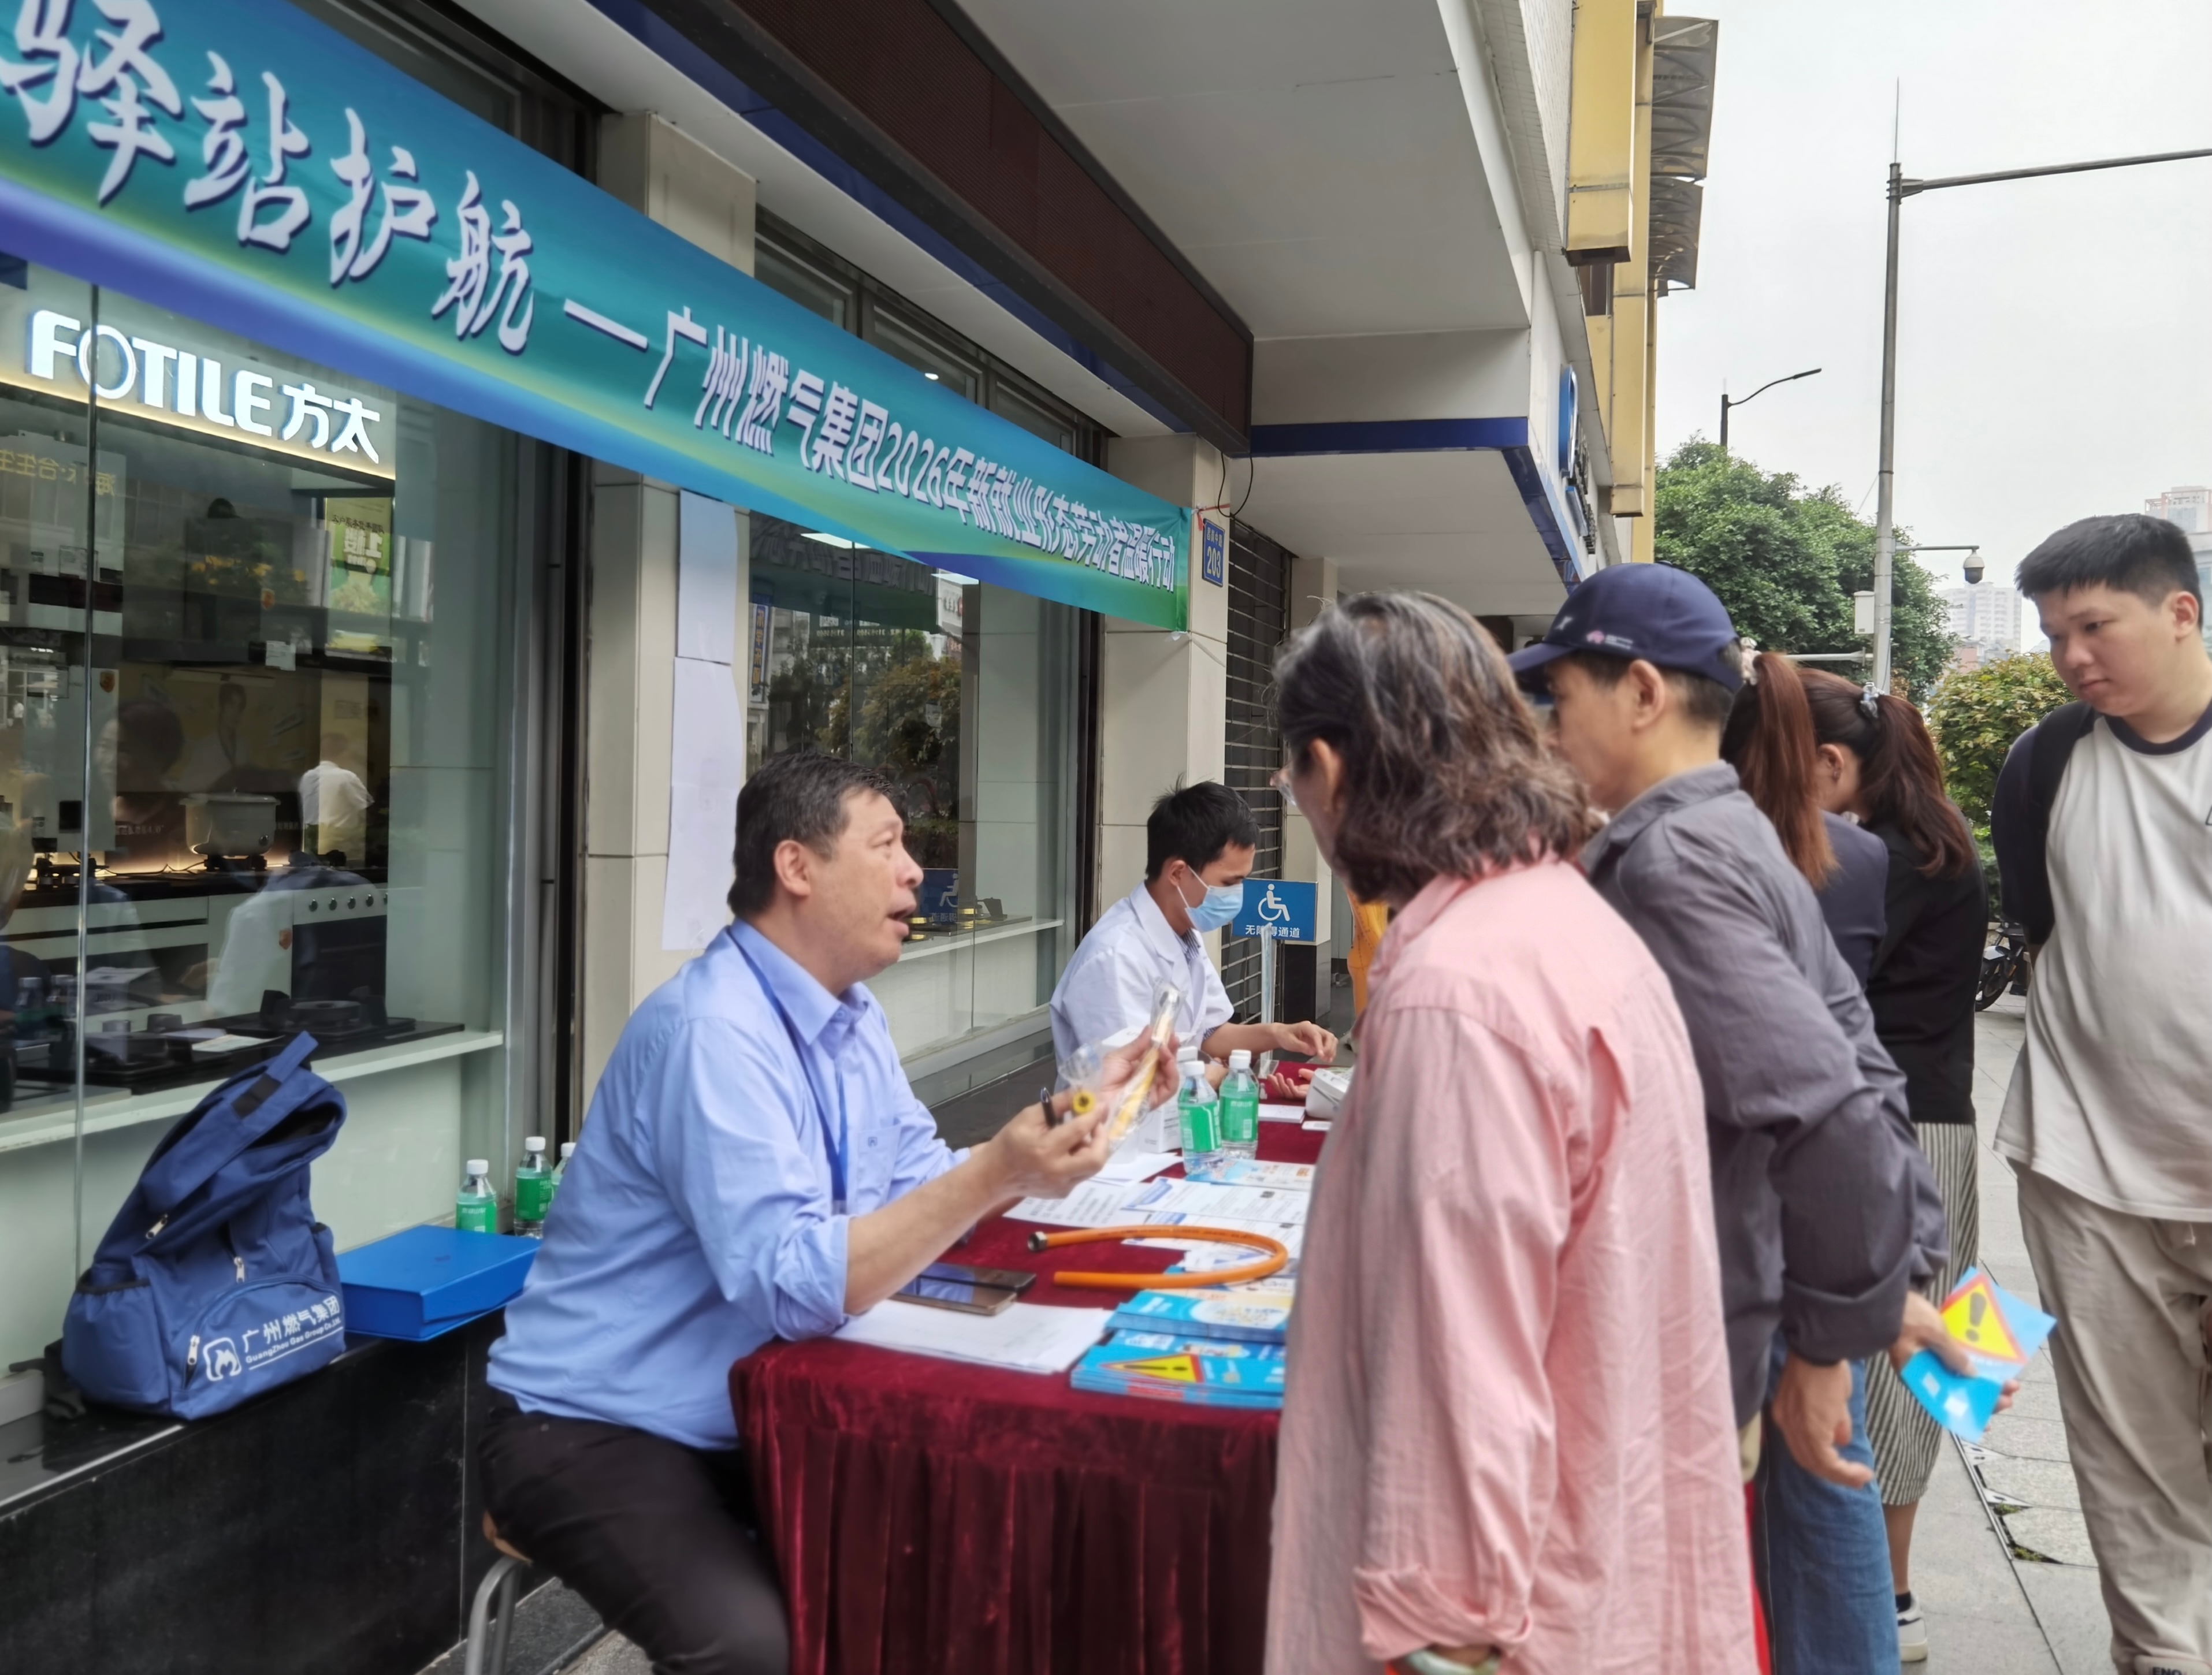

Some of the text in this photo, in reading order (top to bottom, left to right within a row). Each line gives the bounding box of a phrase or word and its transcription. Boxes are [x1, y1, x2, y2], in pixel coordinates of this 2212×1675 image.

[28, 310, 380, 464] FOTILE 方太
[1207, 546, 1221, 578] 203
[242, 1295, 340, 1353] 广州燃气集团
[289, 1335, 304, 1345] Gas
[304, 1326, 325, 1339] Group
